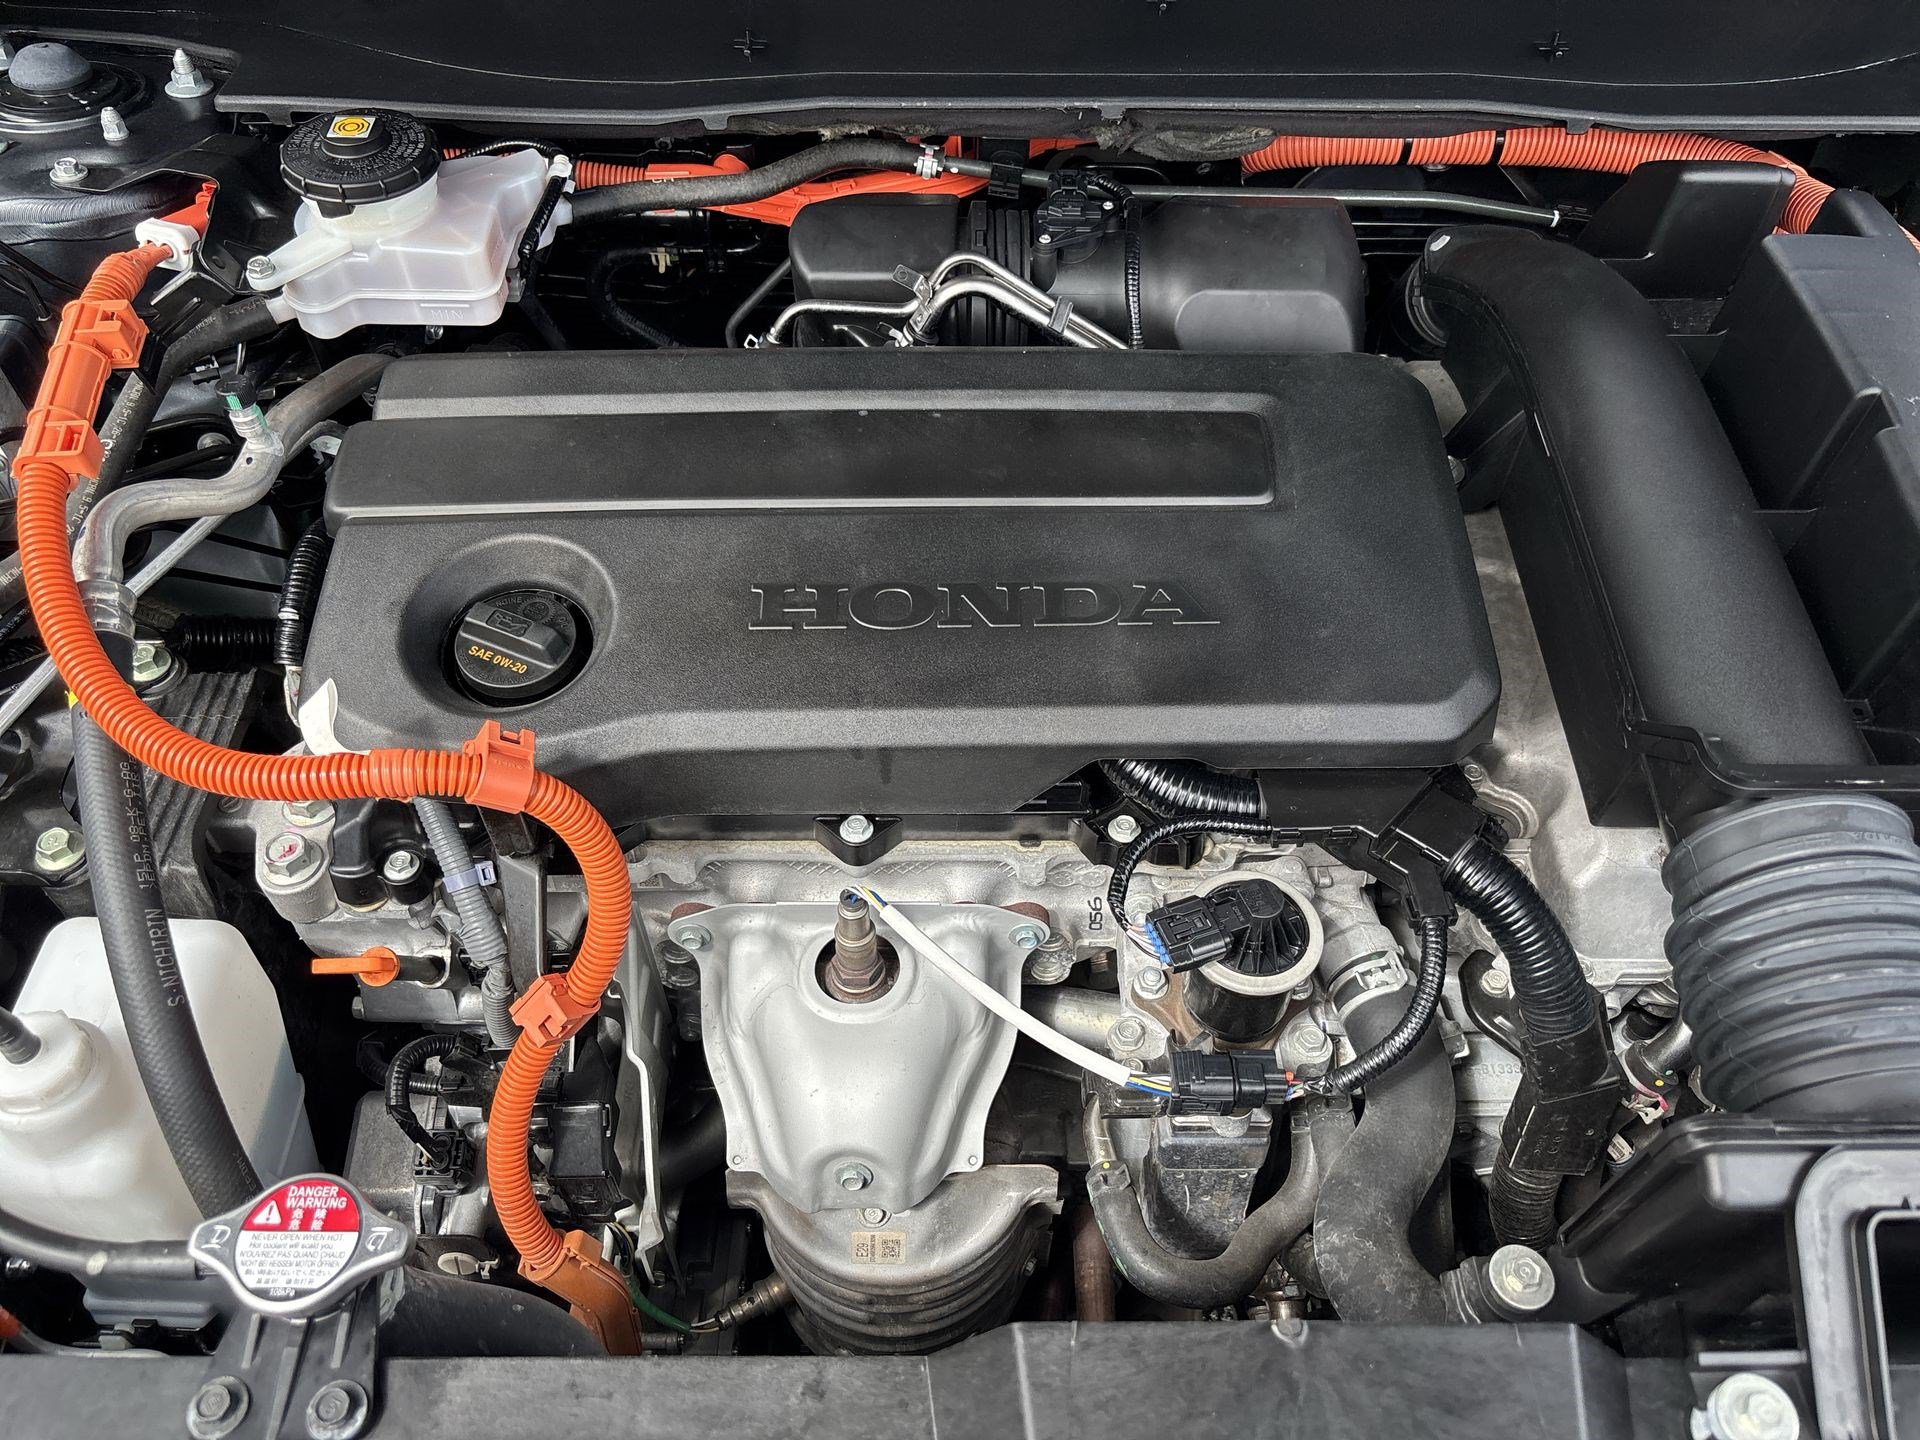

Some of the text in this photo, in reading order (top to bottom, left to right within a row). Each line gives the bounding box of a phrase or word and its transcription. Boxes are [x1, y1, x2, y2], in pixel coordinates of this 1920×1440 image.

[748, 583, 1221, 631] HONDA
[468, 645, 495, 662] SAE
[493, 655, 528, 675] 0W-20
[1087, 896, 1103, 931] 056
[288, 1185, 339, 1197] DANGER
[286, 1196, 348, 1209] WARNUNG
[251, 1233, 278, 1241] NEVER
[279, 1233, 300, 1241] OPEN
[302, 1233, 325, 1241] WHEN
[277, 1250, 292, 1259] PAS
[292, 1250, 319, 1259] QUAND
[856, 1242, 869, 1258] E29
